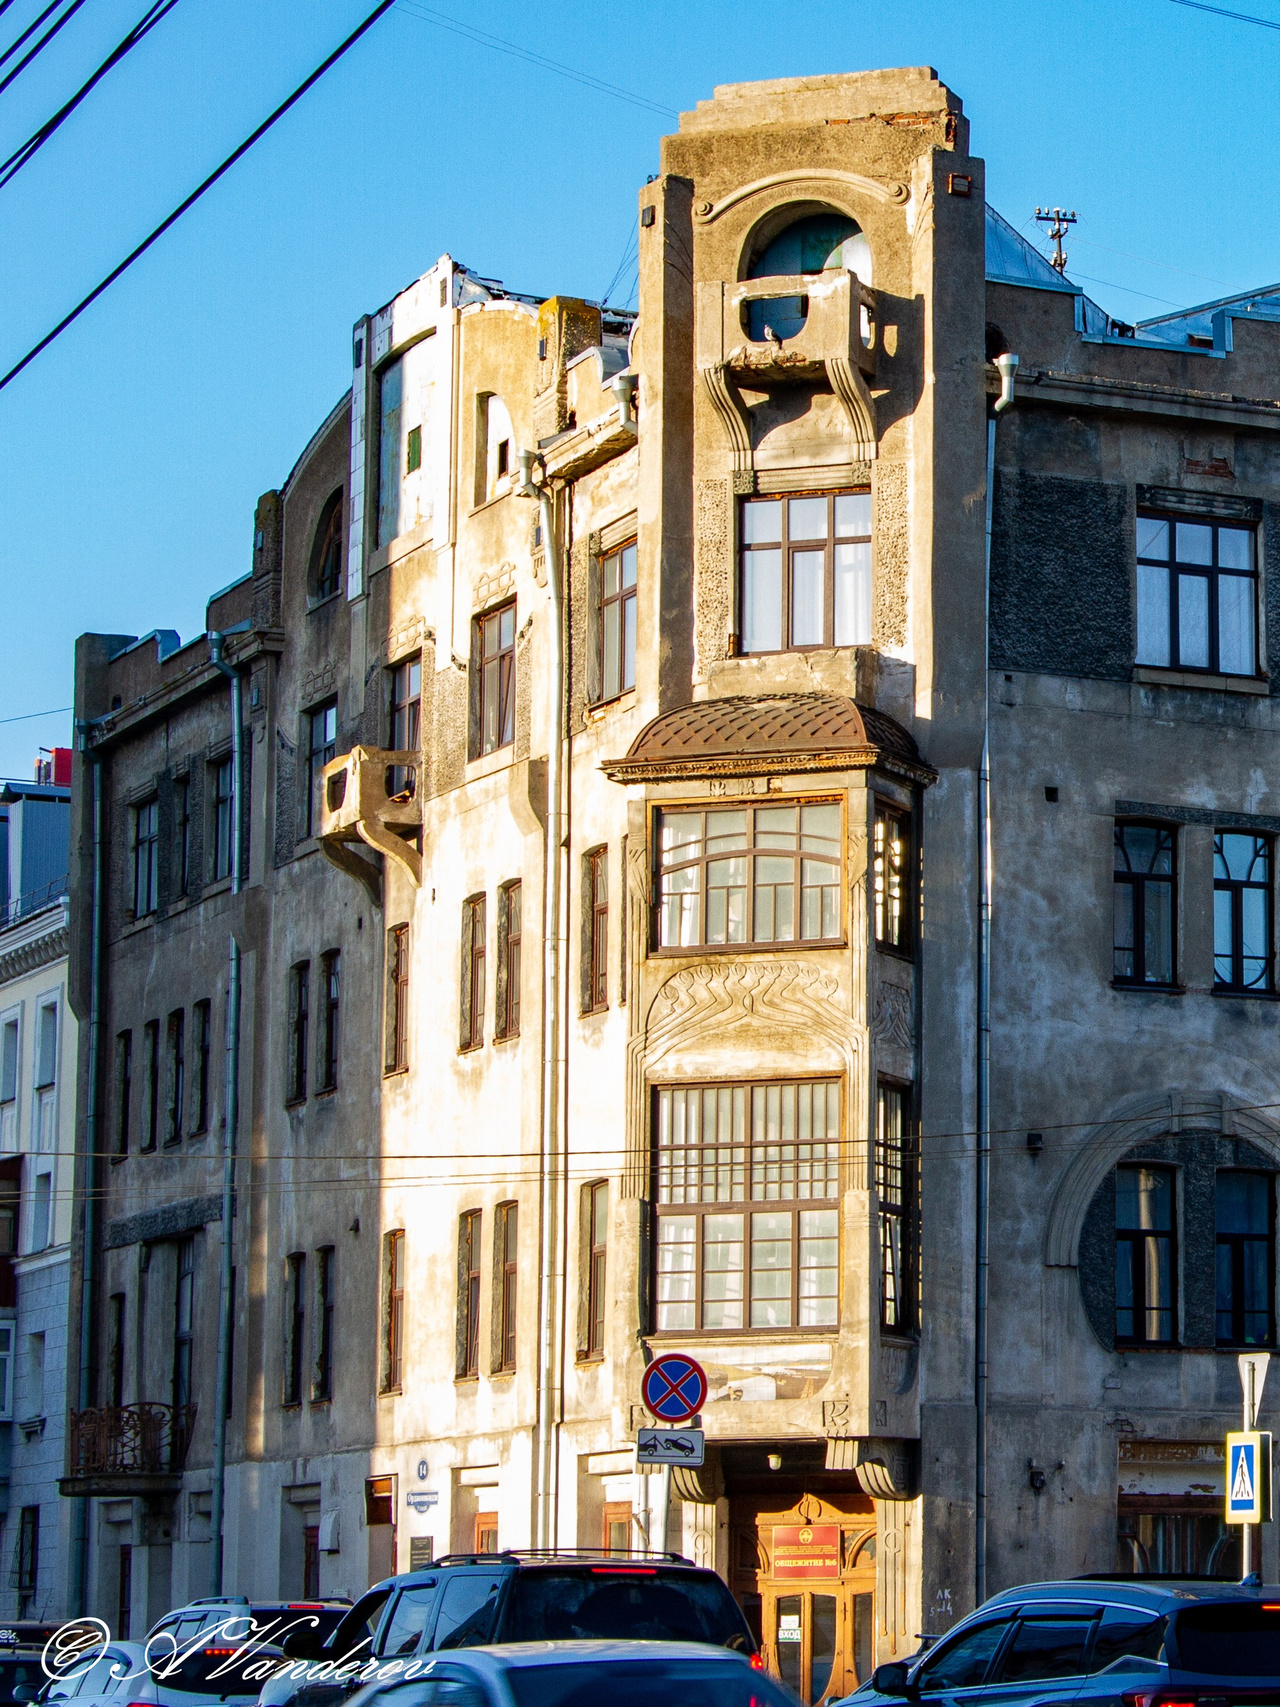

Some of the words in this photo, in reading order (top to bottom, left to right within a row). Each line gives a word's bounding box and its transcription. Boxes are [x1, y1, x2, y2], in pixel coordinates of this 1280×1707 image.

[419, 1464, 427, 1477] 14
[775, 1559, 824, 1568] ОБЩЕЖИТИЕ
[779, 1629, 801, 1640] ВХОД
